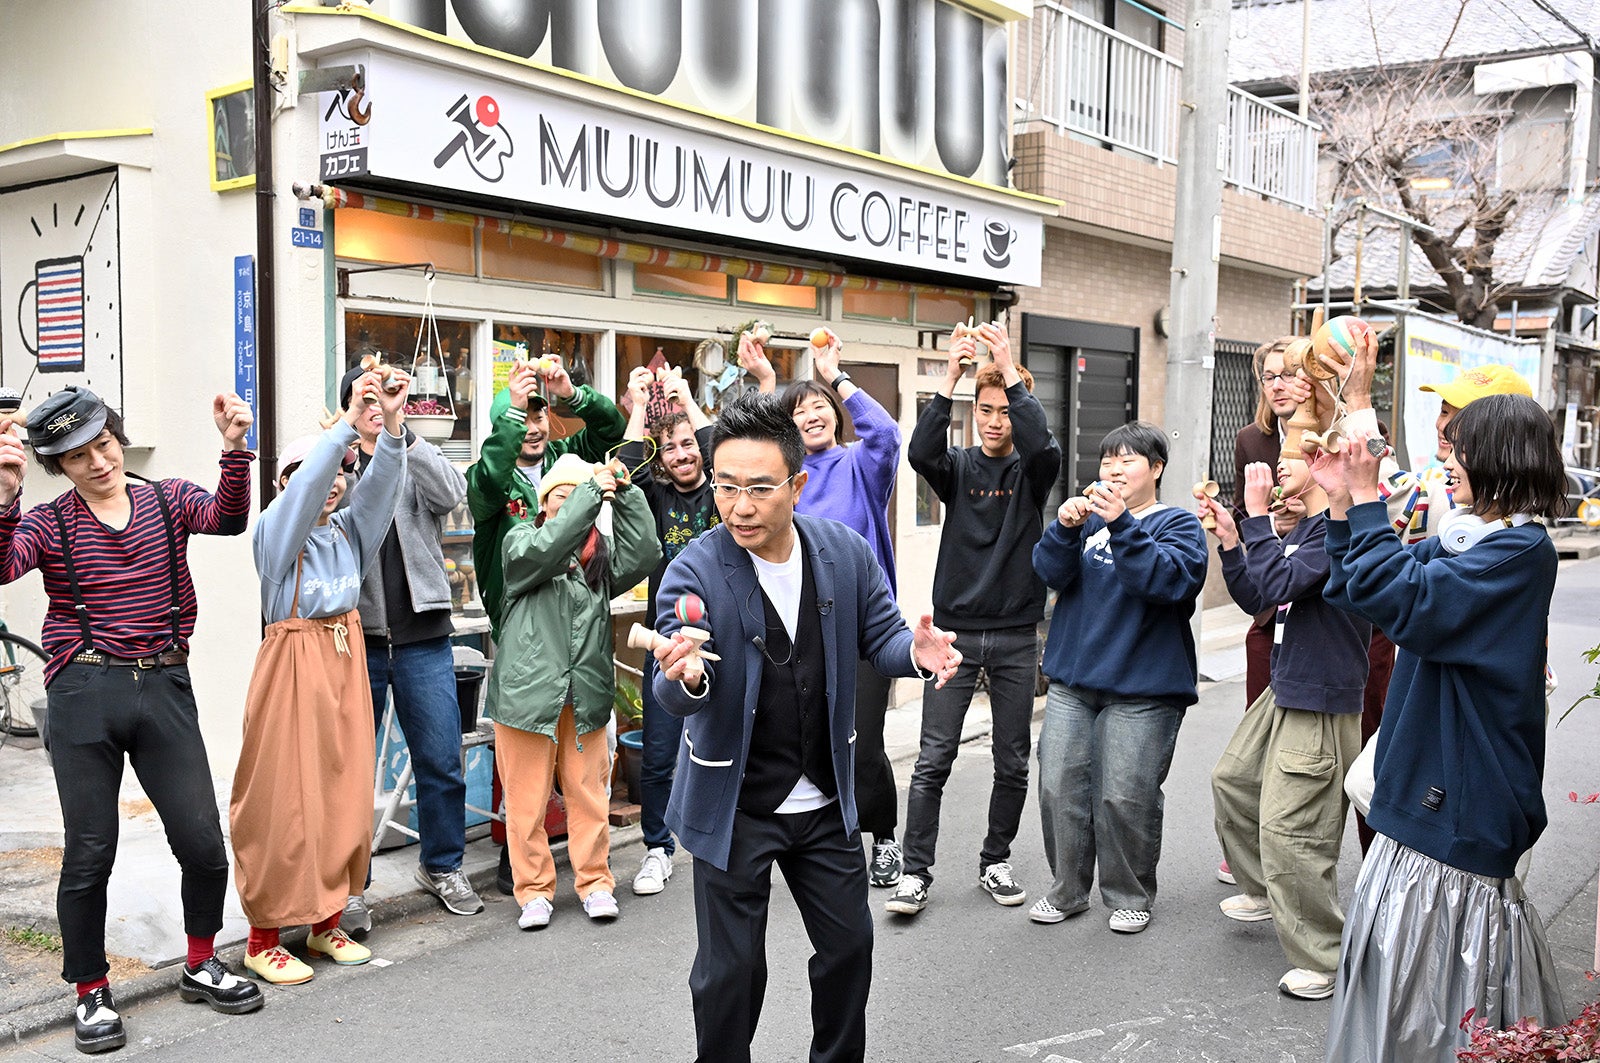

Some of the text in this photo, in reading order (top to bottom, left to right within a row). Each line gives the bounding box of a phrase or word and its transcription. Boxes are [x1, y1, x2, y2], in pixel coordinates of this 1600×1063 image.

[326, 126, 361, 150] けん玉
[325, 154, 361, 177] カフェ
[538, 113, 969, 263] MUUMUU COFFEE
[293, 230, 322, 245] 21-14
